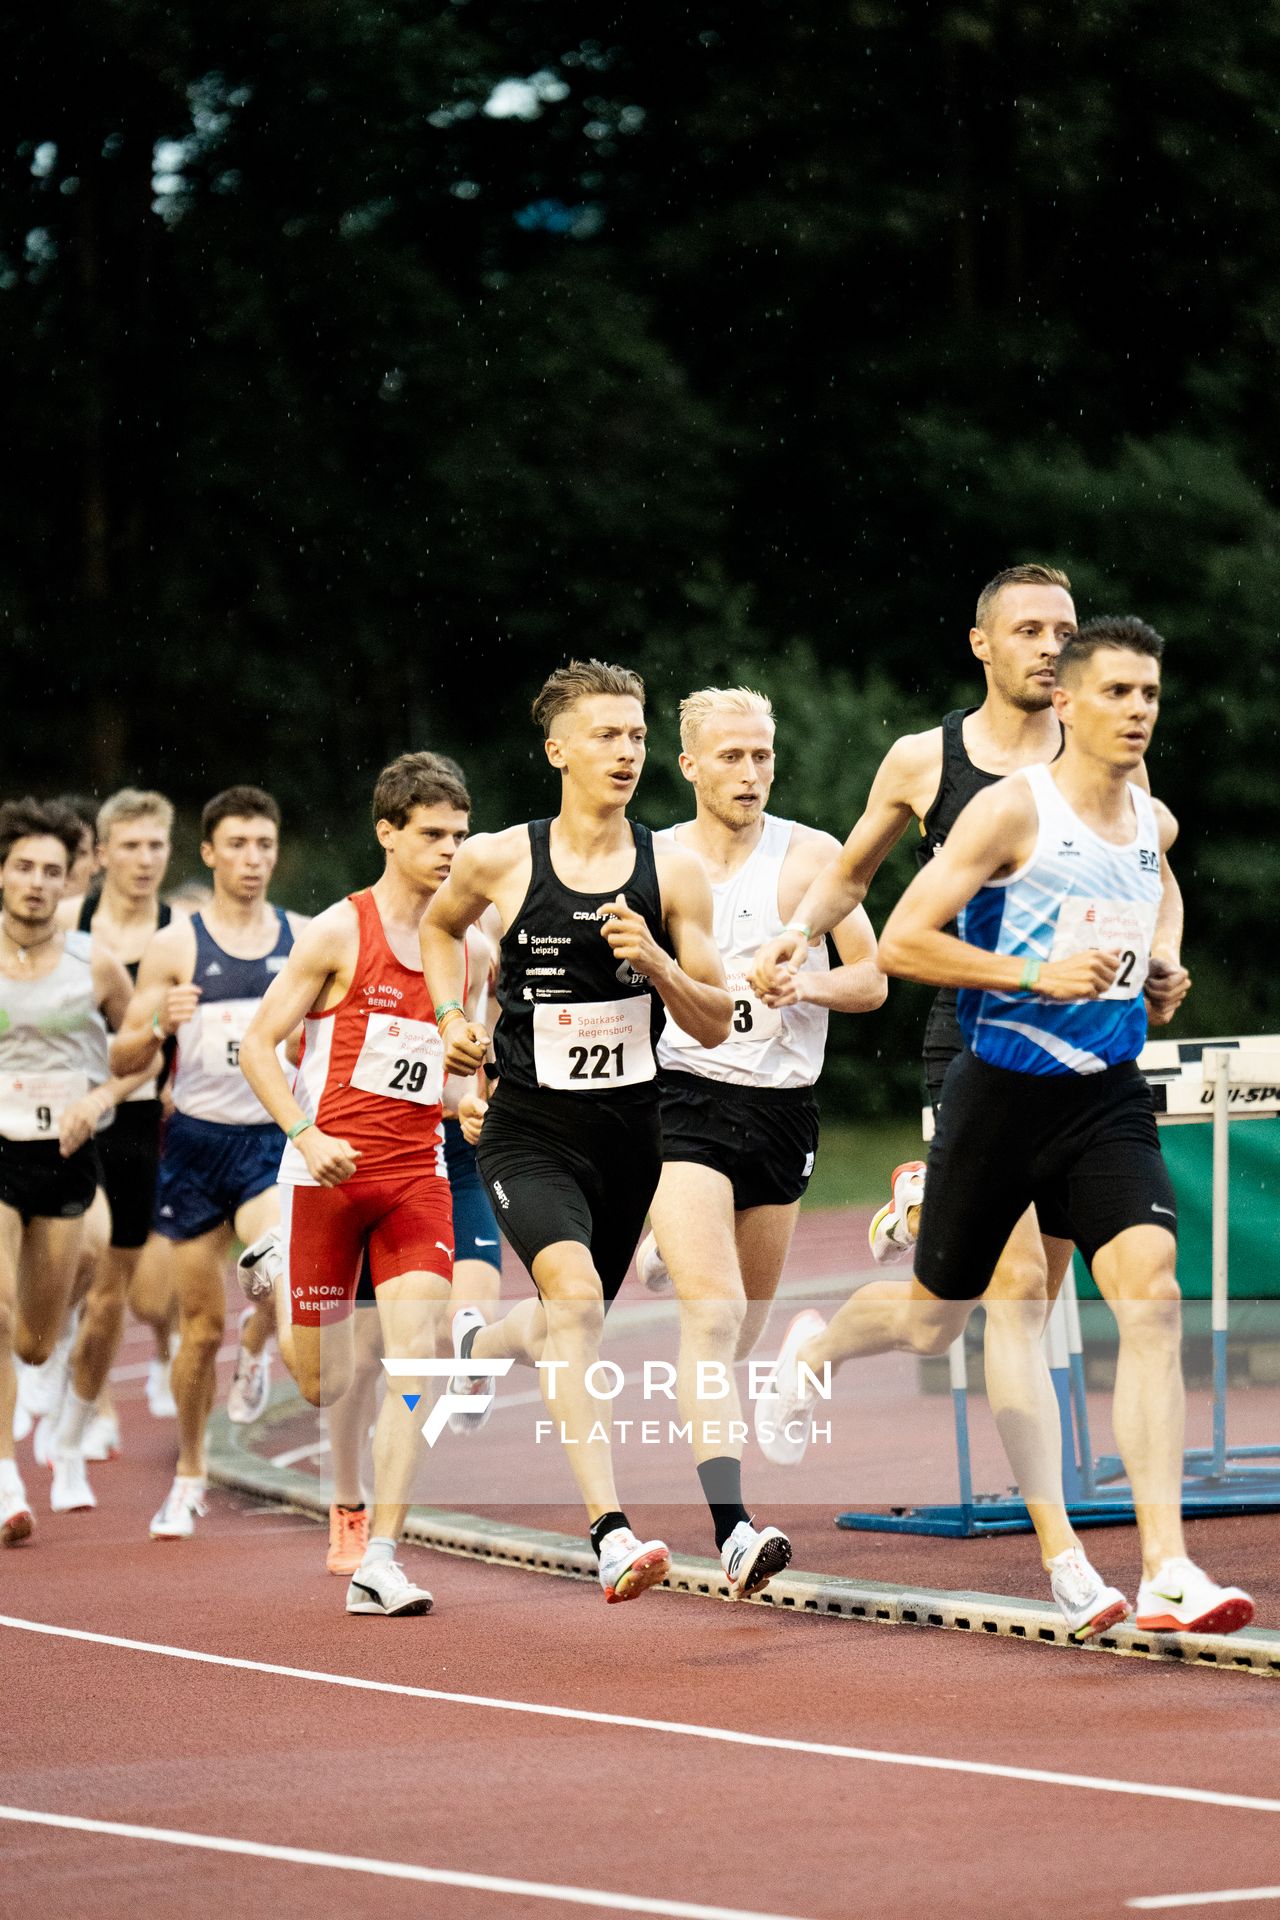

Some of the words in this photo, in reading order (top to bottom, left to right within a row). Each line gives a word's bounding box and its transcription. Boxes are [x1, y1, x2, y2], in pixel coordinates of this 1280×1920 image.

[530, 935, 571, 945] Sparkasse
[531, 946, 559, 956] Leipzig
[363, 986, 376, 996] LG
[378, 985, 404, 1000] NORD
[368, 997, 397, 1008] BERLIN
[577, 1014, 625, 1026] Sparkasse
[578, 1025, 633, 1038] Regensburg
[568, 1042, 624, 1080] 221
[388, 1059, 428, 1093] 29
[36, 1106, 51, 1131] 9
[292, 1287, 304, 1299] LG
[308, 1285, 345, 1297] NORD
[299, 1299, 339, 1311] BERLIN
